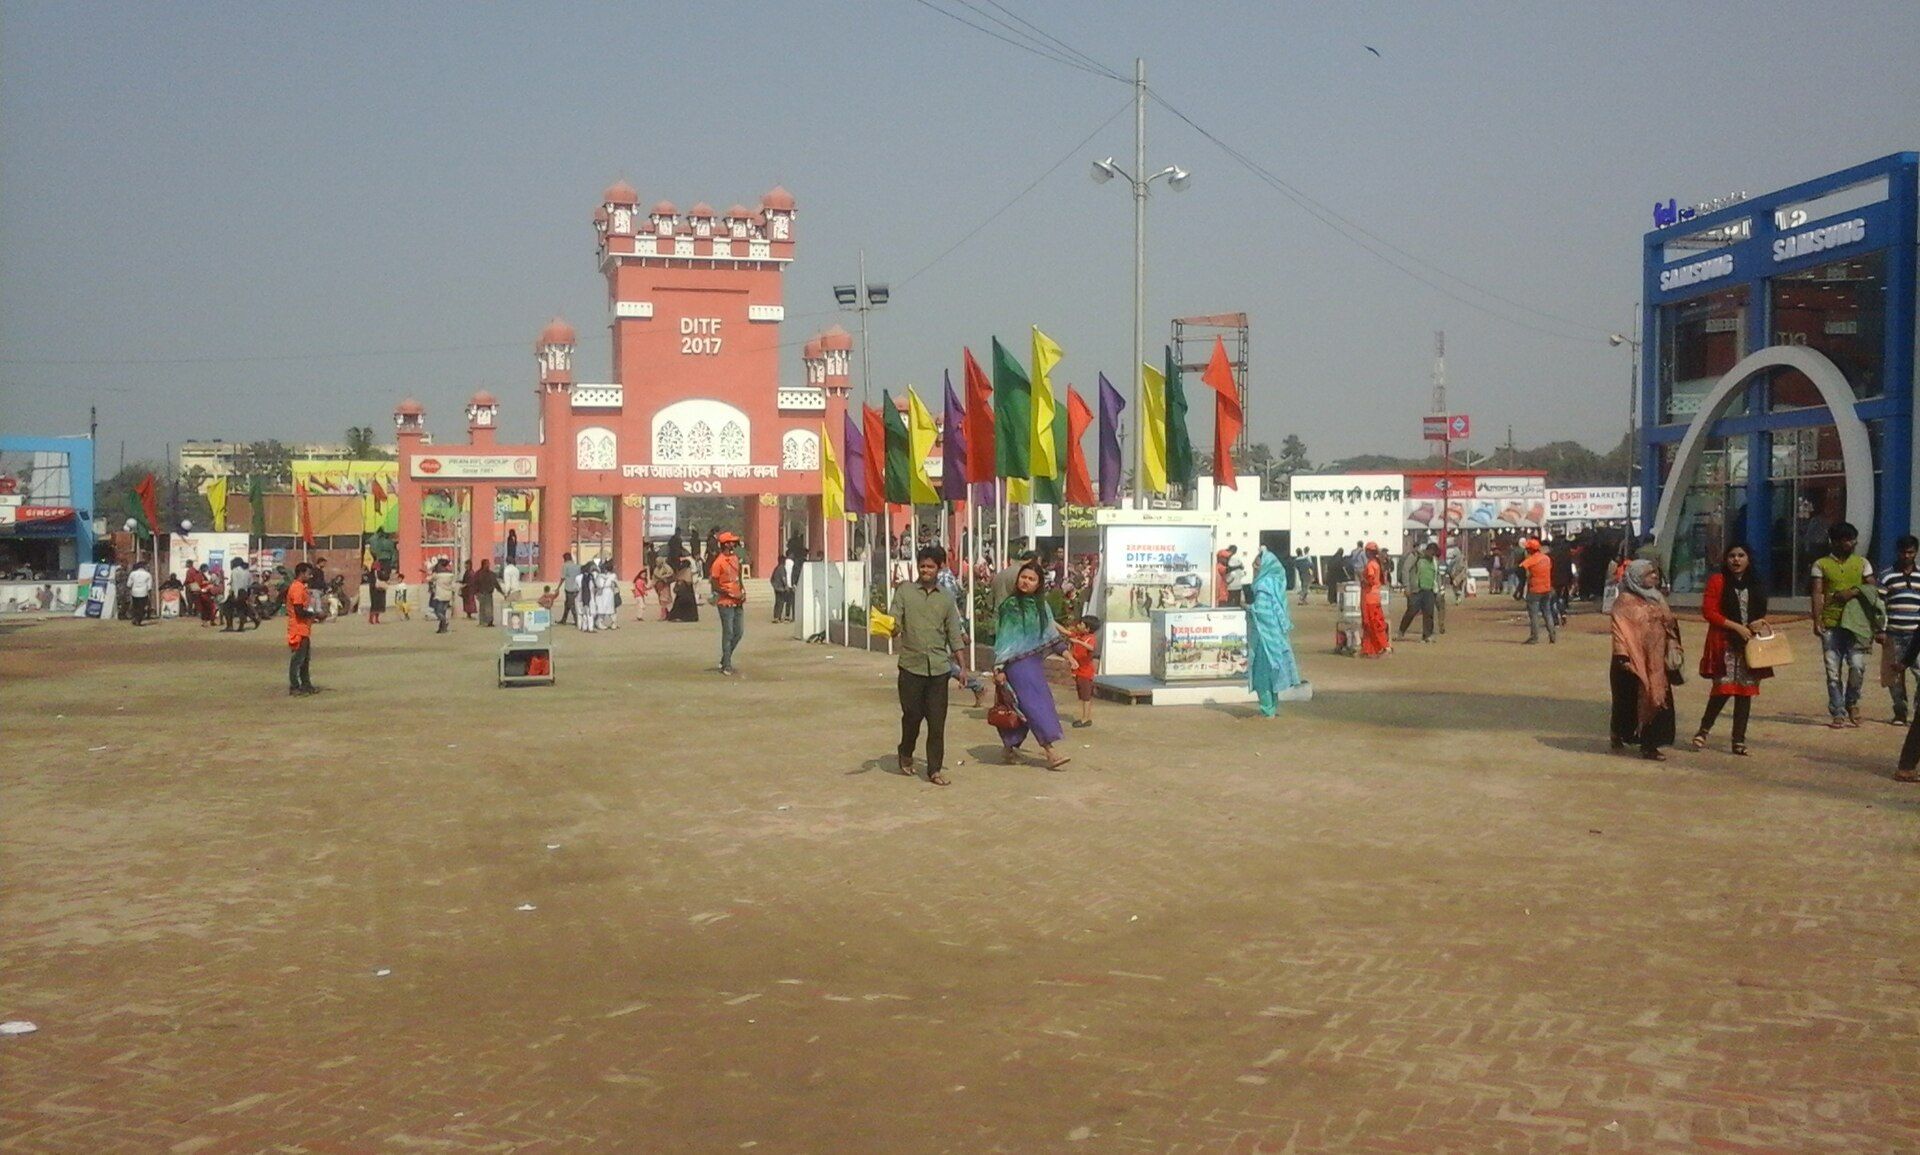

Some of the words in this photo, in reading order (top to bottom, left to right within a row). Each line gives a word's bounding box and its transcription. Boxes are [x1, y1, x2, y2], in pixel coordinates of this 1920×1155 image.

[1773, 218, 1866, 261] SAMSUNG
[1660, 254, 1733, 291] SAMSUNG
[680, 317, 722, 335] DITF
[681, 337, 722, 354] 2017
[622, 464, 648, 478] ঢাকা
[683, 480, 722, 494] ২০১৭
[1365, 490, 1371, 500] ও
[26, 508, 66, 517] SINGER
[1126, 544, 1176, 552] EXPERIENCE
